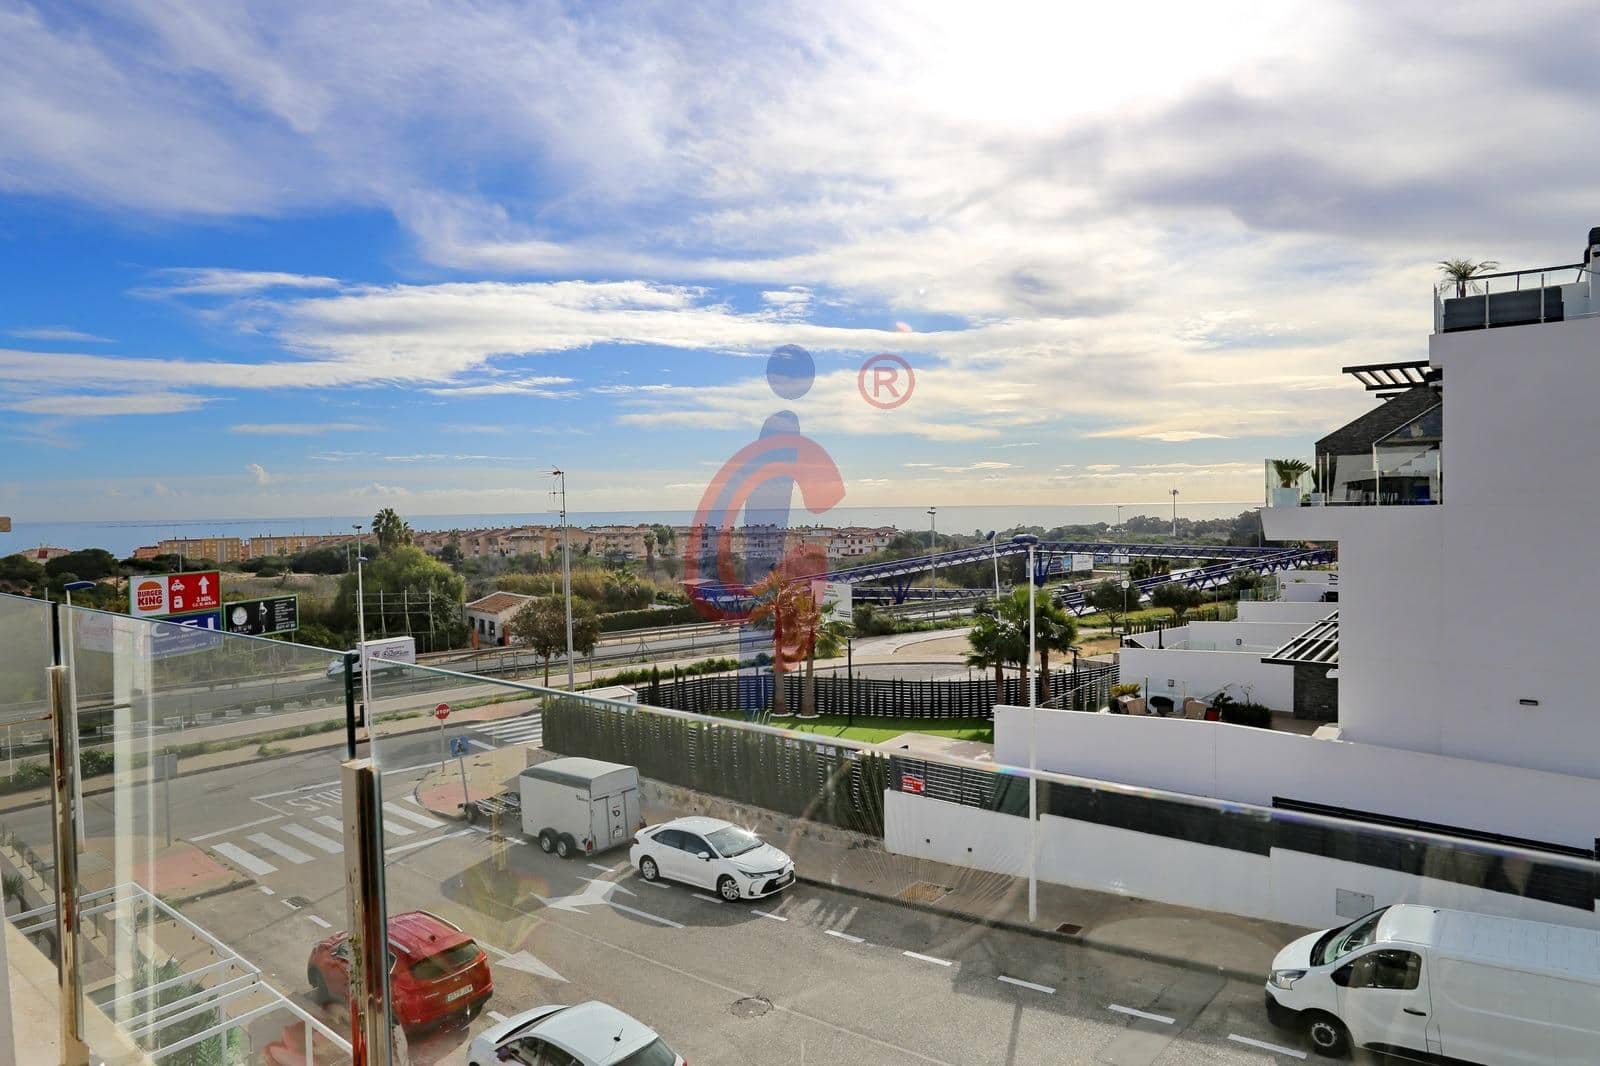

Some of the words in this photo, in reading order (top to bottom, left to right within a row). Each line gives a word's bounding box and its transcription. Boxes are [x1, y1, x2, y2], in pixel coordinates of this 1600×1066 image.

[137, 589, 163, 597] BURGER
[137, 596, 163, 606] KING
[436, 708, 450, 716] STOP
